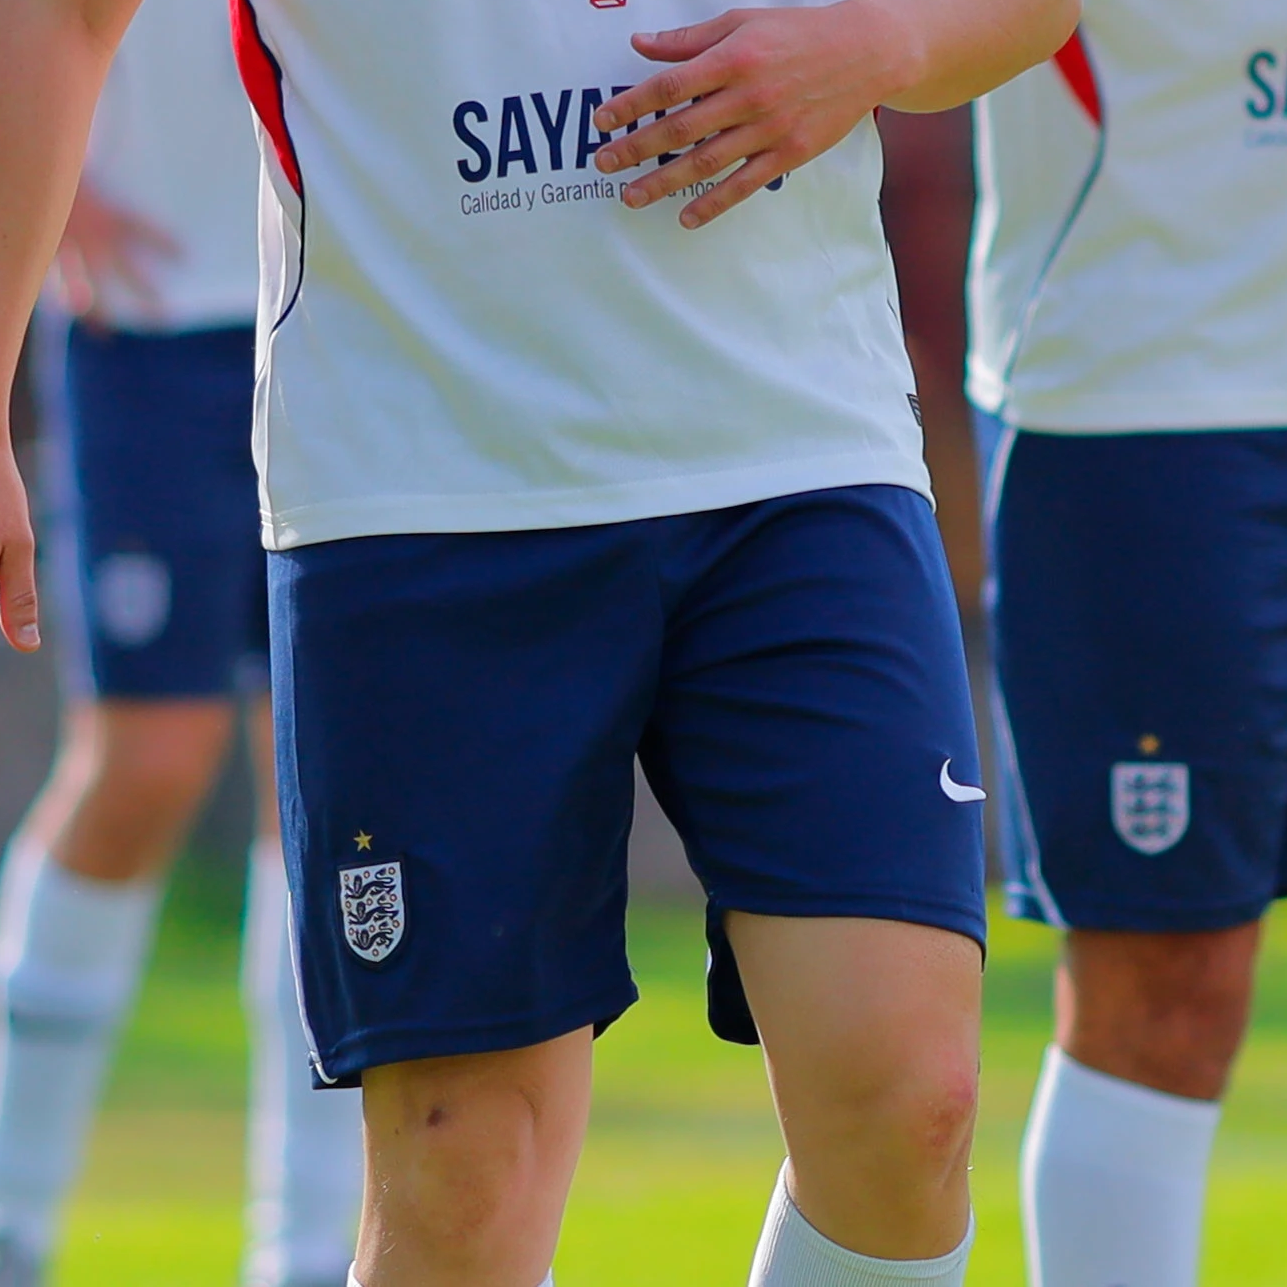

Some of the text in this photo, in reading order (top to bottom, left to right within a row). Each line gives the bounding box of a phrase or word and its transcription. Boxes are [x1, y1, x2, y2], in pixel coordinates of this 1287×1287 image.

[461, 187, 521, 216] Calidad
[525, 188, 536, 211] y
[541, 177, 614, 204] Garantía
